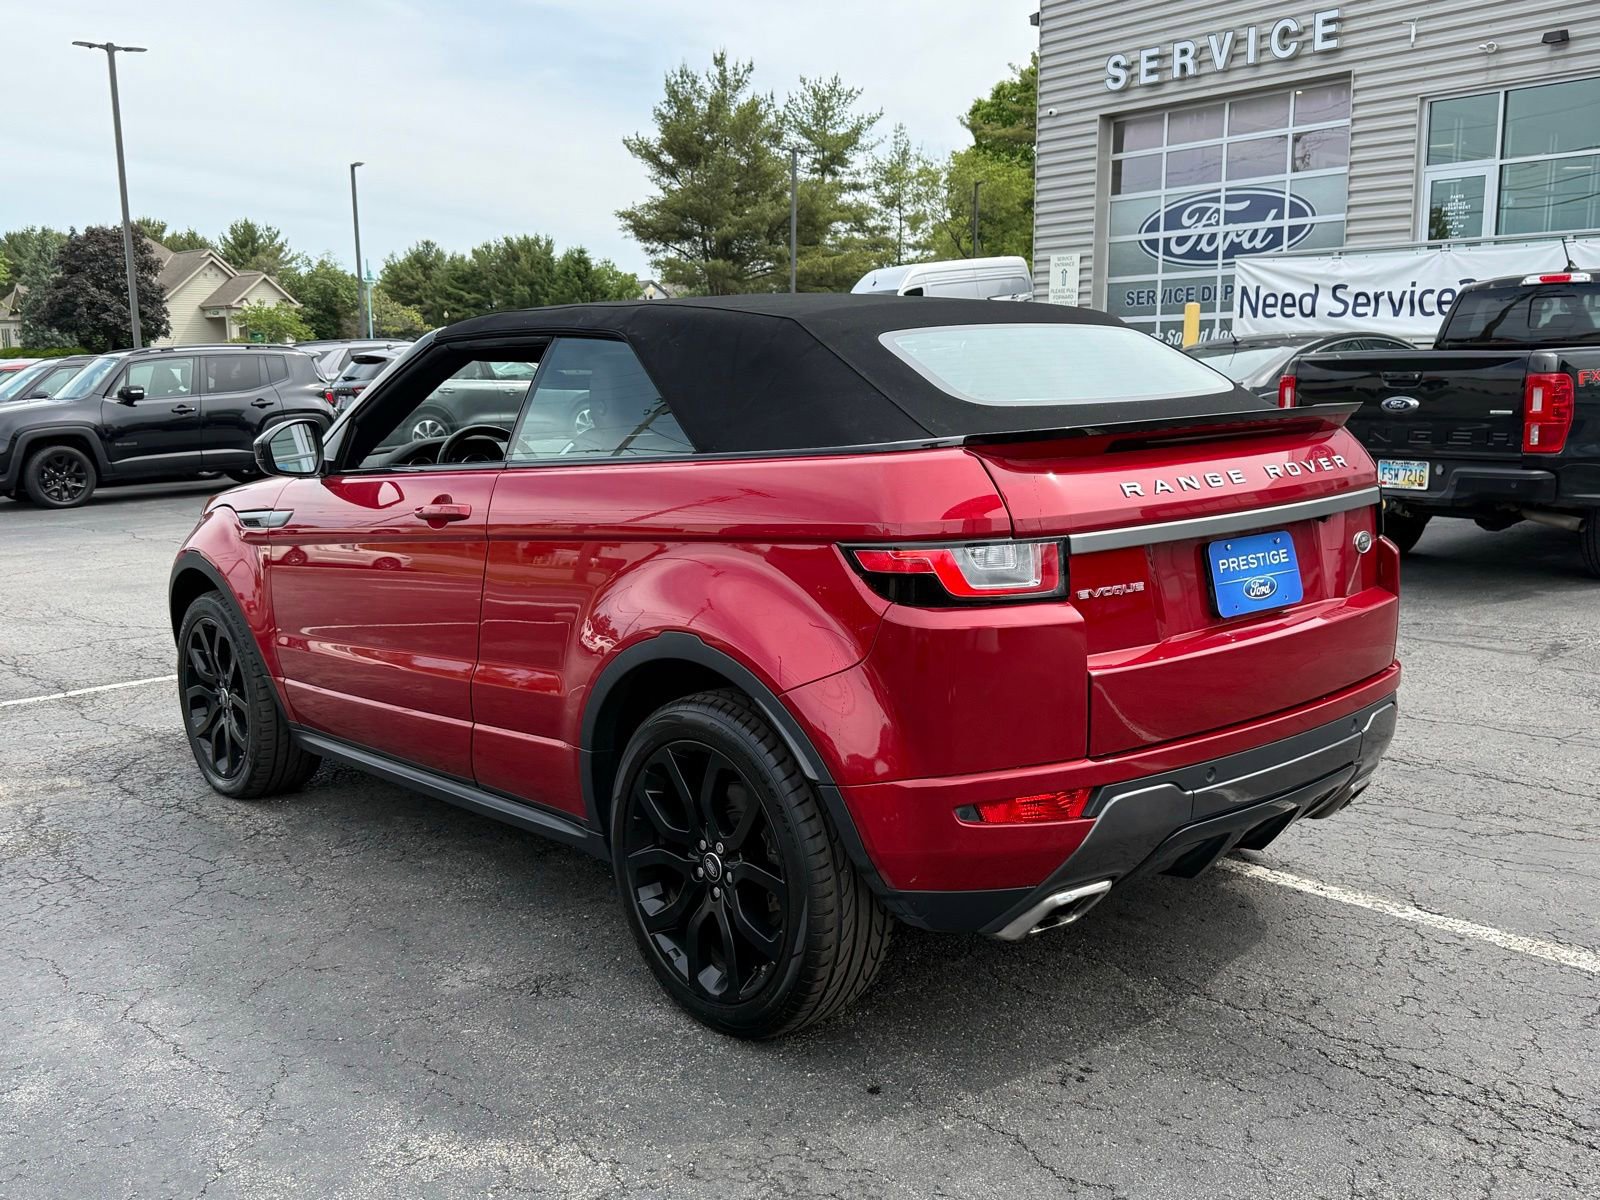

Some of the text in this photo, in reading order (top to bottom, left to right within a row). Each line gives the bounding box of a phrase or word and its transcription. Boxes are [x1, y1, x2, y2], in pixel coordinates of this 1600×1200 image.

[1105, 8, 1340, 91] SERVICE
[1170, 200, 1278, 254] Ford
[1126, 287, 1195, 306] SERVICE
[1239, 278, 1477, 318] Need Service
[1120, 455, 1348, 498] RANGE ROVER
[1381, 467, 1425, 483] FSW 7216
[1218, 548, 1290, 574] PRESTIGE
[1076, 581, 1145, 600] EVOQUE
[1249, 578, 1271, 597] Ford
